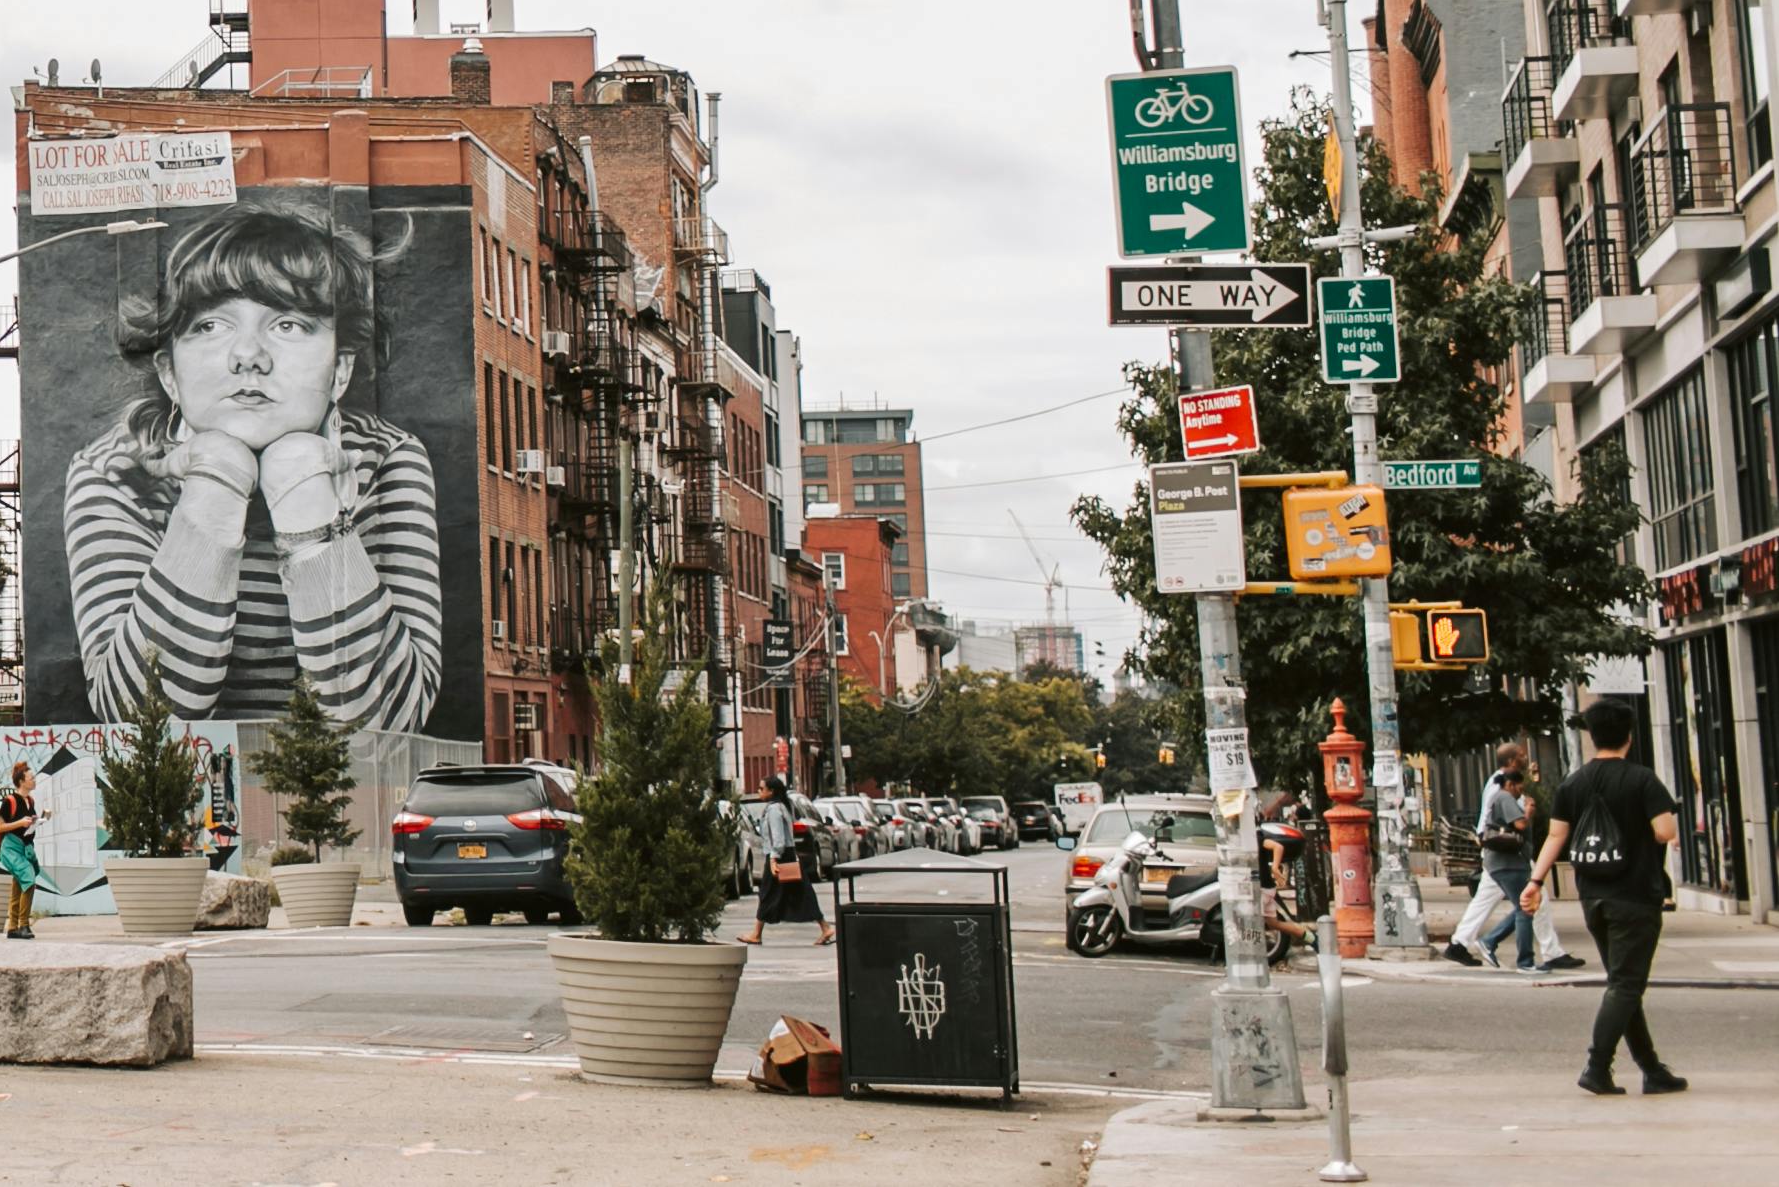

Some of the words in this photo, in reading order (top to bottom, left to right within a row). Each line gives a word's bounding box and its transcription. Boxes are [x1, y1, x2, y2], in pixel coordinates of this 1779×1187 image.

[35, 147, 69, 170] LOT
[74, 145, 108, 168] FOR
[159, 139, 220, 159] Crifasi
[1119, 142, 1237, 165] Williamsburg
[152, 178, 233, 202] 718-908-4223
[1145, 171, 1215, 195] Bridge
[42, 190, 65, 209] CALL
[67, 189, 84, 208] SAL
[85, 187, 116, 207] JOSEPH
[1137, 284, 1193, 307] ONE
[1220, 284, 1277, 307] WAY
[1323, 312, 1394, 326] Williamsburg
[1341, 327, 1377, 341] Bridge
[1337, 342, 1357, 353] Ped
[1359, 341, 1384, 353] Path
[1183, 401, 1197, 415] NO
[1198, 394, 1242, 412] STANDING
[1185, 413, 1223, 430] Anytime
[1385, 463, 1456, 486] Bedford
[1463, 464, 1478, 475] Av
[1157, 488, 1193, 500] George
[1193, 486, 1204, 497] B.
[1204, 485, 1228, 496] Post
[1158, 500, 1185, 511] Plaza
[1209, 733, 1245, 743] MOVING
[1225, 752, 1245, 766] $19
[1058, 793, 1097, 805] FedEx
[1569, 848, 1623, 863] TIDAL
